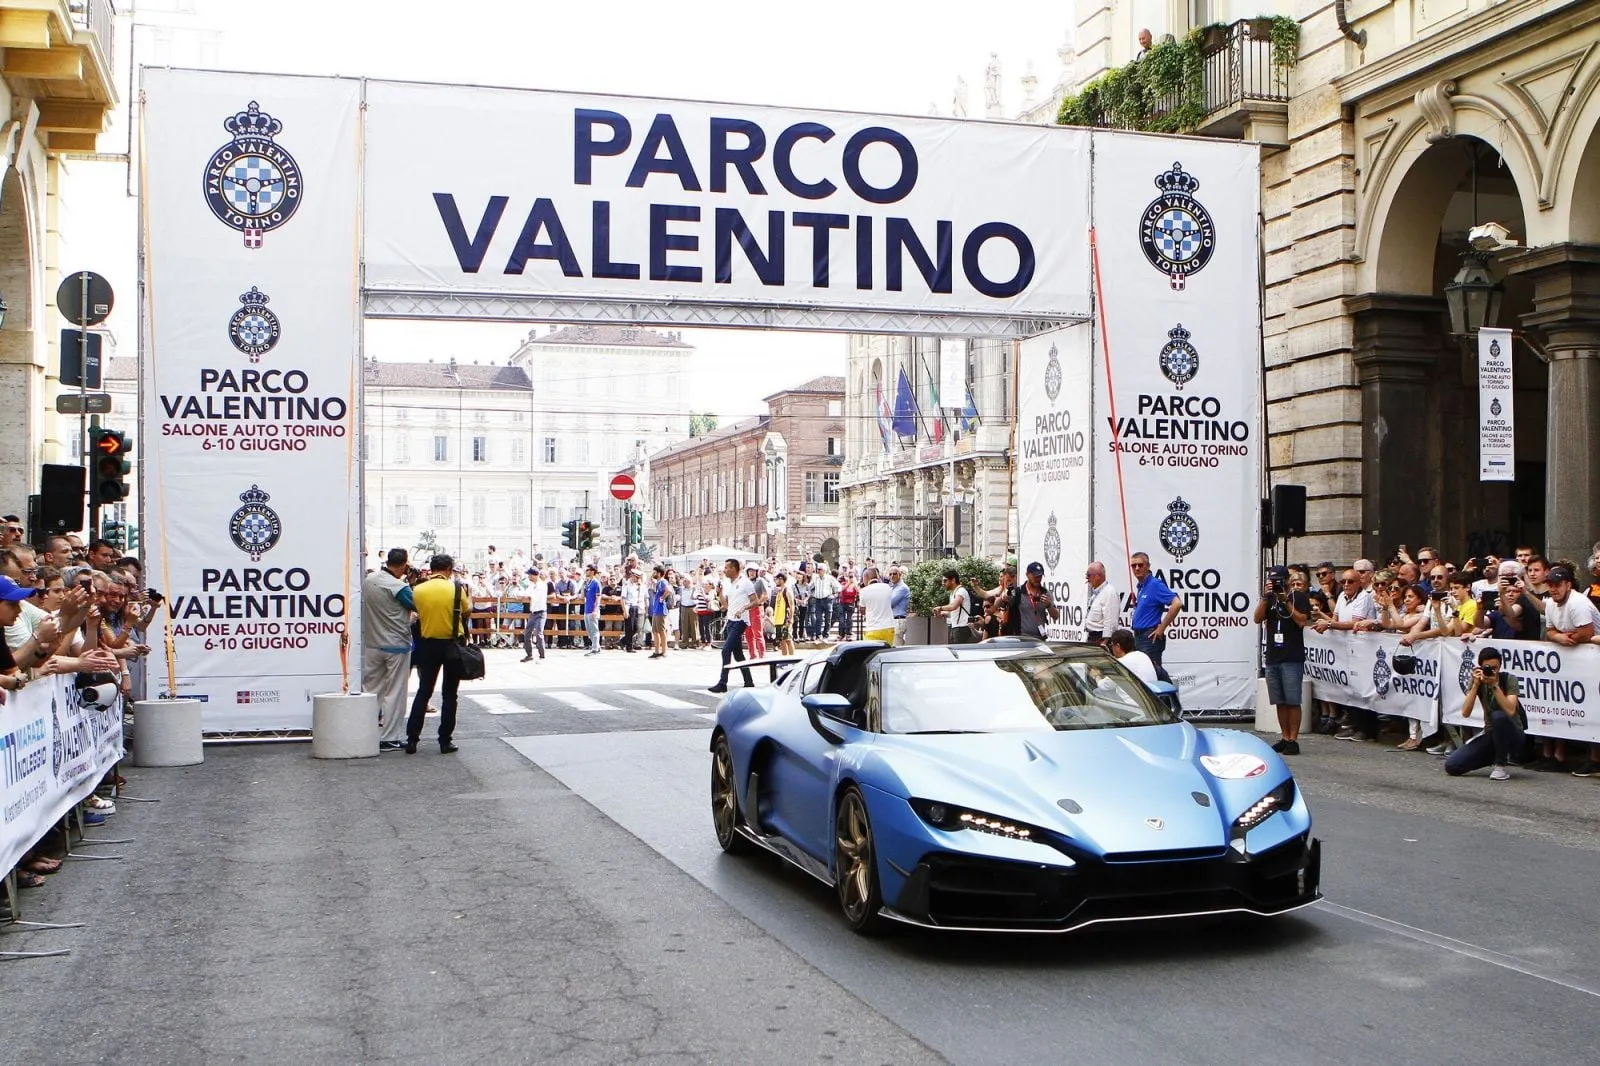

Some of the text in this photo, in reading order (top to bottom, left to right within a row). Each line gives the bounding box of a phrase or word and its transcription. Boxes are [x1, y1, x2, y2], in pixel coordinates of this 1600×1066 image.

[574, 107, 918, 204] PARCO
[209, 143, 298, 199] PARCO VALENTINO
[224, 208, 283, 229] TORINO
[1144, 198, 1211, 248] PARCO VALENTINO
[432, 192, 1036, 298] VALENTINO
[1155, 258, 1200, 273] TORINO
[201, 369, 309, 393] PARCO
[160, 395, 347, 421] VALENTINO
[1138, 394, 1221, 417] PARCO
[161, 423, 346, 437] SALONE AUTO TORINO
[1035, 409, 1070, 435] PARCO
[1107, 416, 1249, 442] VALENTINO
[202, 438, 307, 451] 6-10 GIUGNO
[1023, 431, 1084, 459] VALENTINO
[1109, 441, 1248, 456] SALONE AUTO TORINO
[1023, 456, 1084, 473] SALONE AUTO TORINO
[1139, 455, 1219, 467] 6-10 GIUGNO
[1047, 469, 1070, 482] GIUGNO
[202, 567, 311, 592] PARCO
[1155, 568, 1221, 590] ARCO
[163, 593, 346, 620] VALENTINO
[235, 622, 280, 635] AUTO
[285, 621, 346, 635] TORINO
[1168, 616, 1249, 627] UTO TORINO
[204, 636, 309, 650] 6-10 GIUGNO
[1061, 629, 1082, 641] TORINO
[1167, 629, 1219, 640] GIUGNO
[1304, 646, 1336, 665] REMIO
[1501, 648, 1561, 674] PARCO
[1303, 663, 1348, 686] ALENTINO
[1392, 677, 1435, 698] PARCO
[1518, 676, 1586, 704] ENTINO
[1524, 704, 1586, 718] TORINO 6-10 GIUGNO
